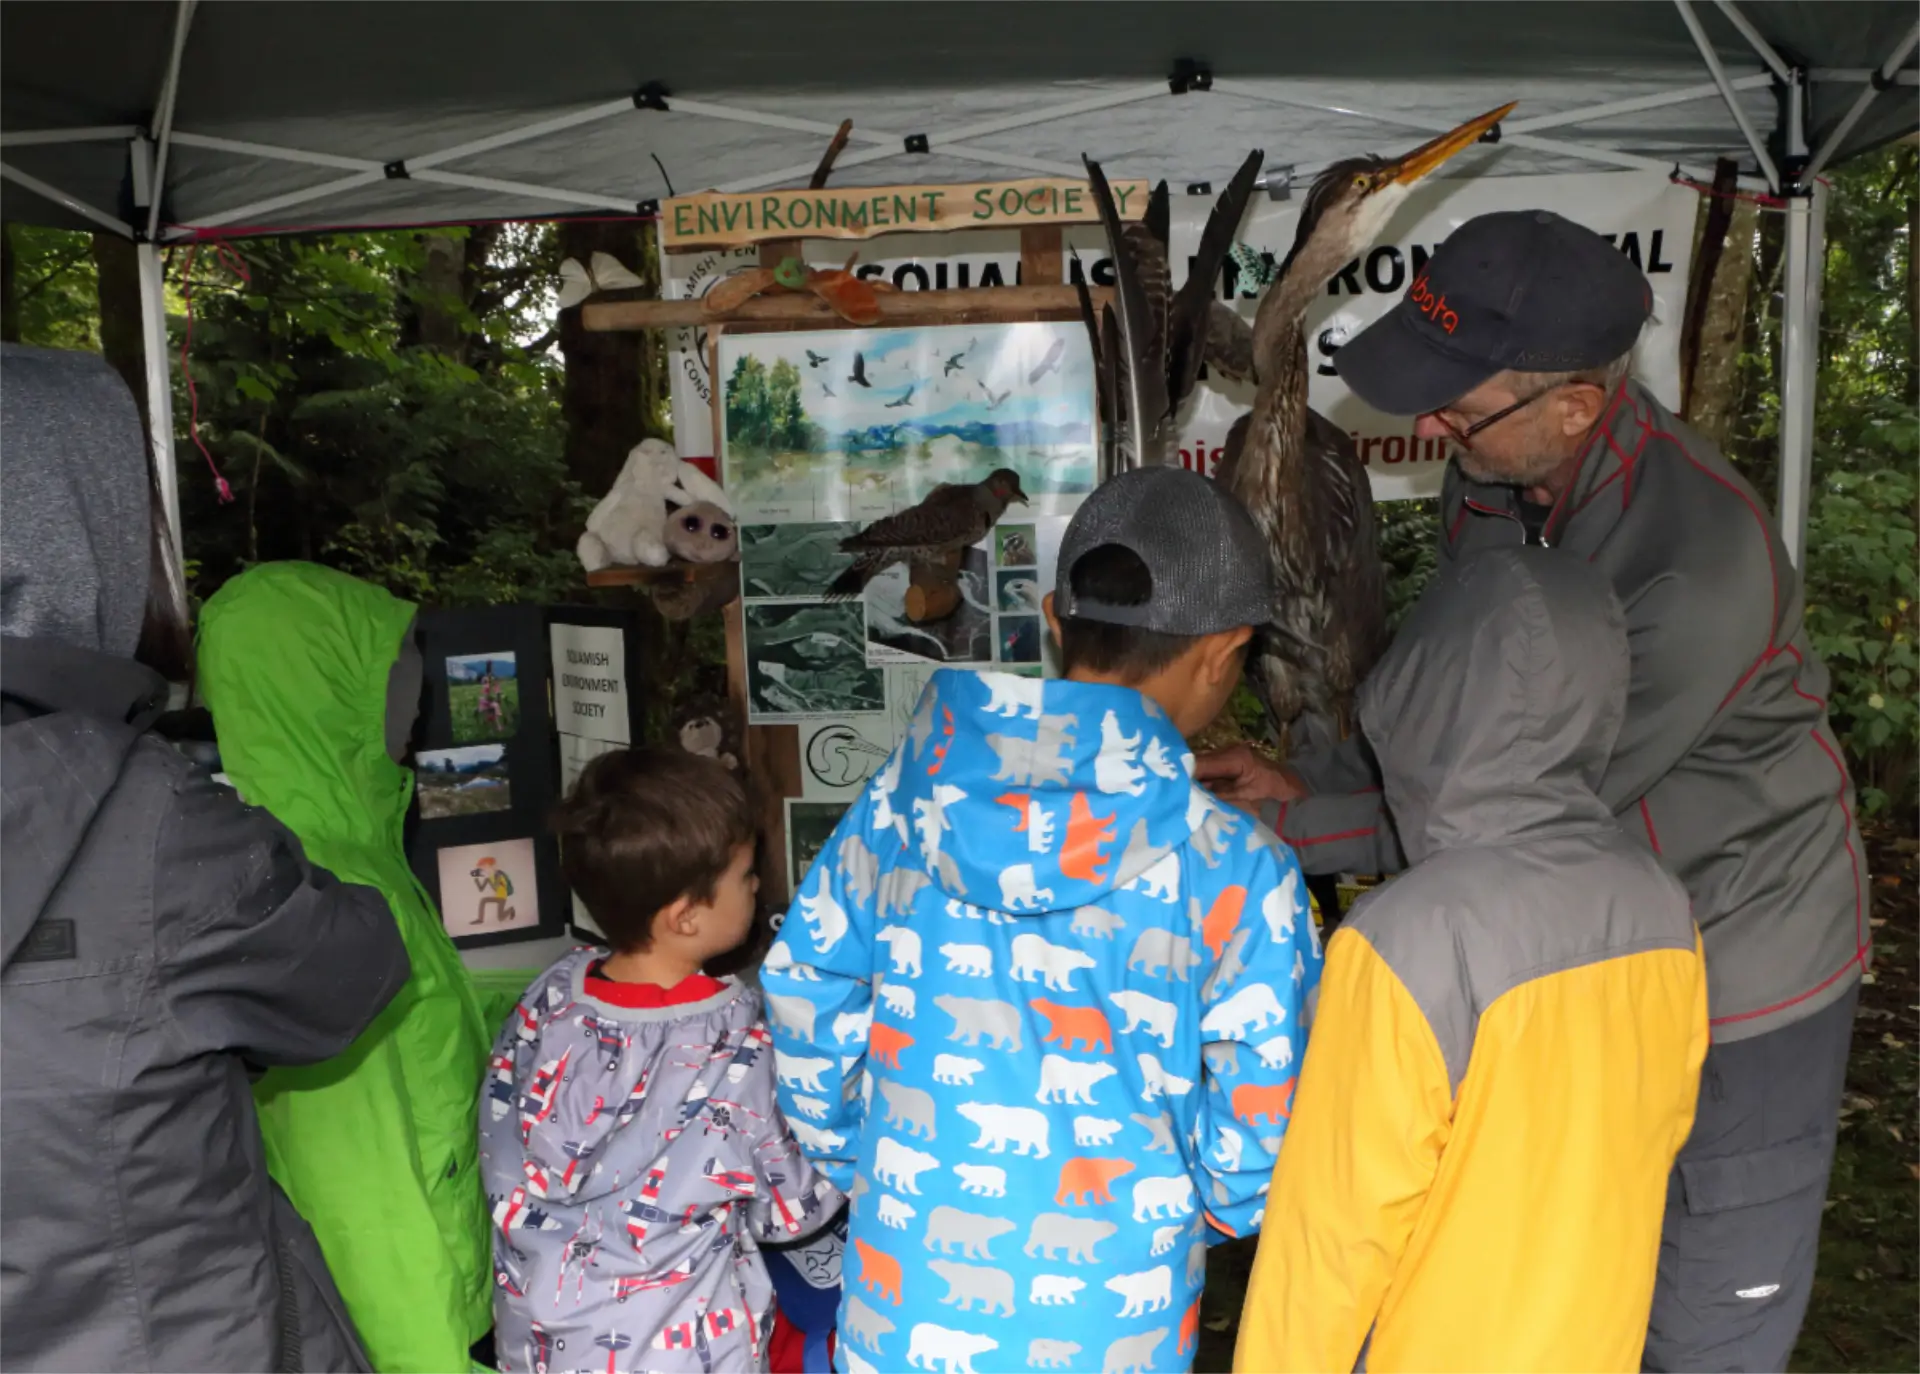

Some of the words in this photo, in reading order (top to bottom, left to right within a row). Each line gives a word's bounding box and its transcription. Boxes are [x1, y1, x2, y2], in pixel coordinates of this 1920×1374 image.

[674, 191, 945, 236] ENVIRONMENT
[973, 185, 1136, 220] SOCIEY
[572, 700, 606, 718] SOCIETY
